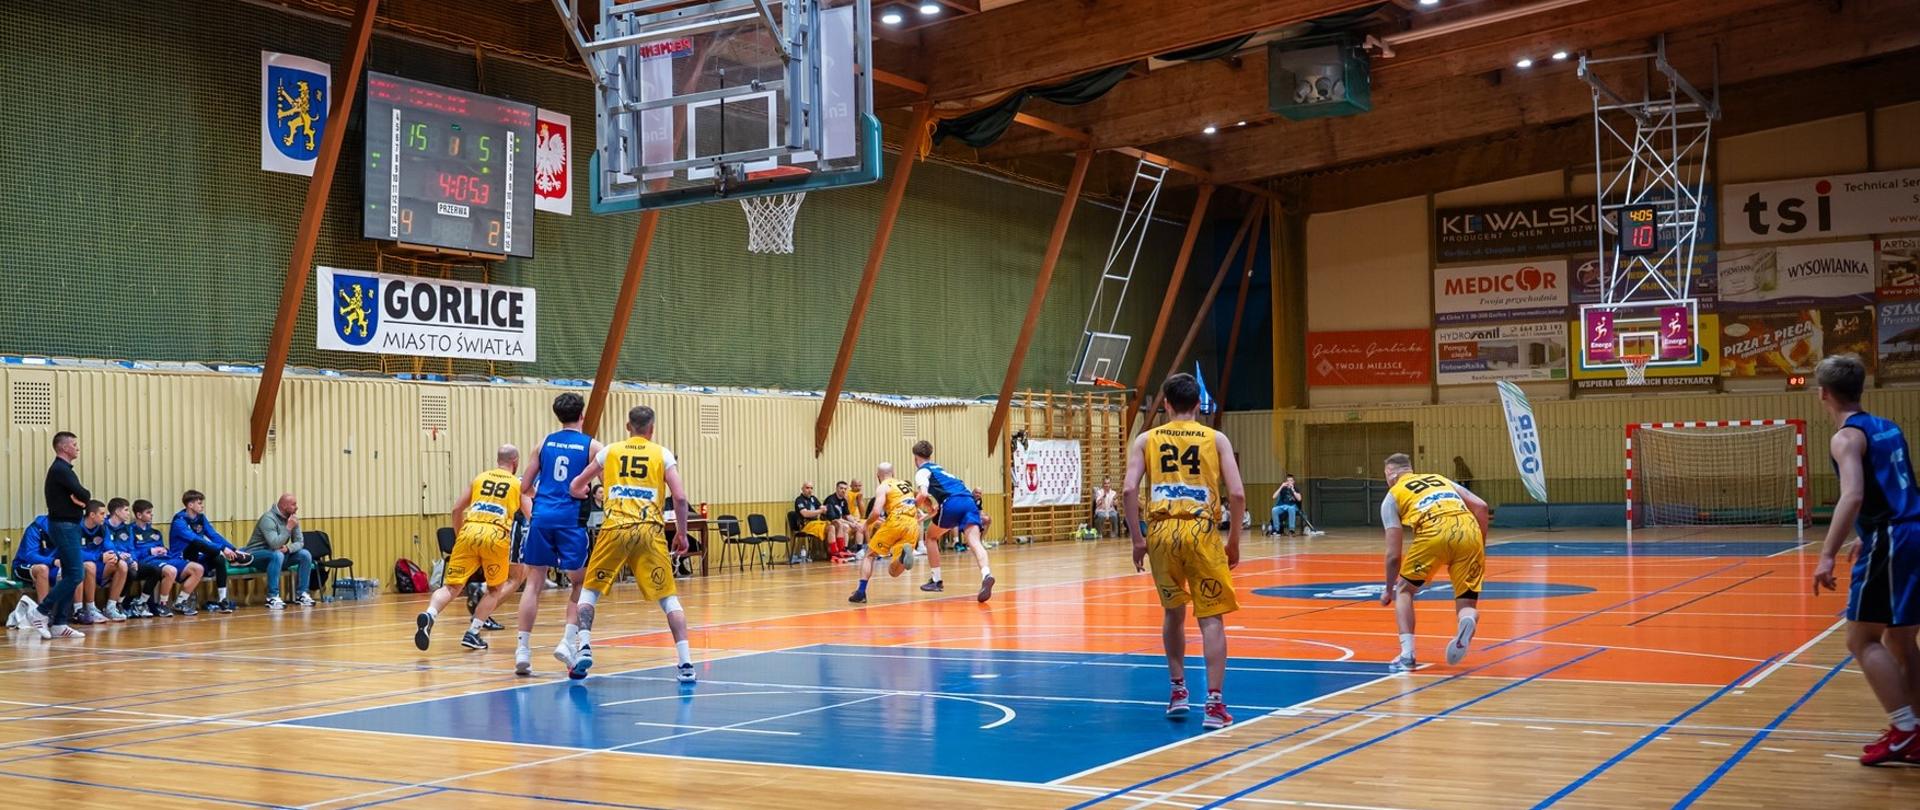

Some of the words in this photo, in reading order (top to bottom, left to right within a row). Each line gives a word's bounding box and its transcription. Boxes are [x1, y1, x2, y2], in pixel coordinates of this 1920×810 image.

[409, 123, 427, 150] 15
[480, 136, 490, 161] 5
[1844, 178, 1898, 192] Technical
[439, 203, 468, 216] PRZERWA
[1630, 209, 1653, 222] 4:05
[1743, 180, 1832, 235] tsi
[488, 220, 500, 246] 2
[1443, 232, 1503, 242] PRODUCENT
[1512, 229, 1543, 238] OKIEN
[1563, 225, 1597, 234] DRZWI
[1631, 225, 1653, 247] 10
[1788, 257, 1869, 278] WYSOWIANKA
[1445, 267, 1556, 296] MEDICOR
[383, 280, 524, 328] GORLICE
[1480, 297, 1504, 305] Twoja
[1505, 294, 1558, 305] przychodnia
[383, 331, 452, 352] MIASTO
[457, 332, 524, 356] ŚWIATŁA
[1590, 342, 1612, 350] Energa
[1723, 336, 1759, 357] PIZZA
[1763, 333, 1772, 345] Z
[1774, 320, 1812, 341] PIECA
[1335, 362, 1364, 370] TWOJE
[1366, 361, 1403, 370] MIEJSCE
[1578, 379, 1613, 388] WSPIERA
[1662, 376, 1714, 386] KOSZYKARZY
[553, 455, 569, 482] 6
[619, 455, 649, 478] 15
[1160, 443, 1201, 475] 24
[480, 479, 510, 499] 98
[1405, 475, 1446, 494] 95
